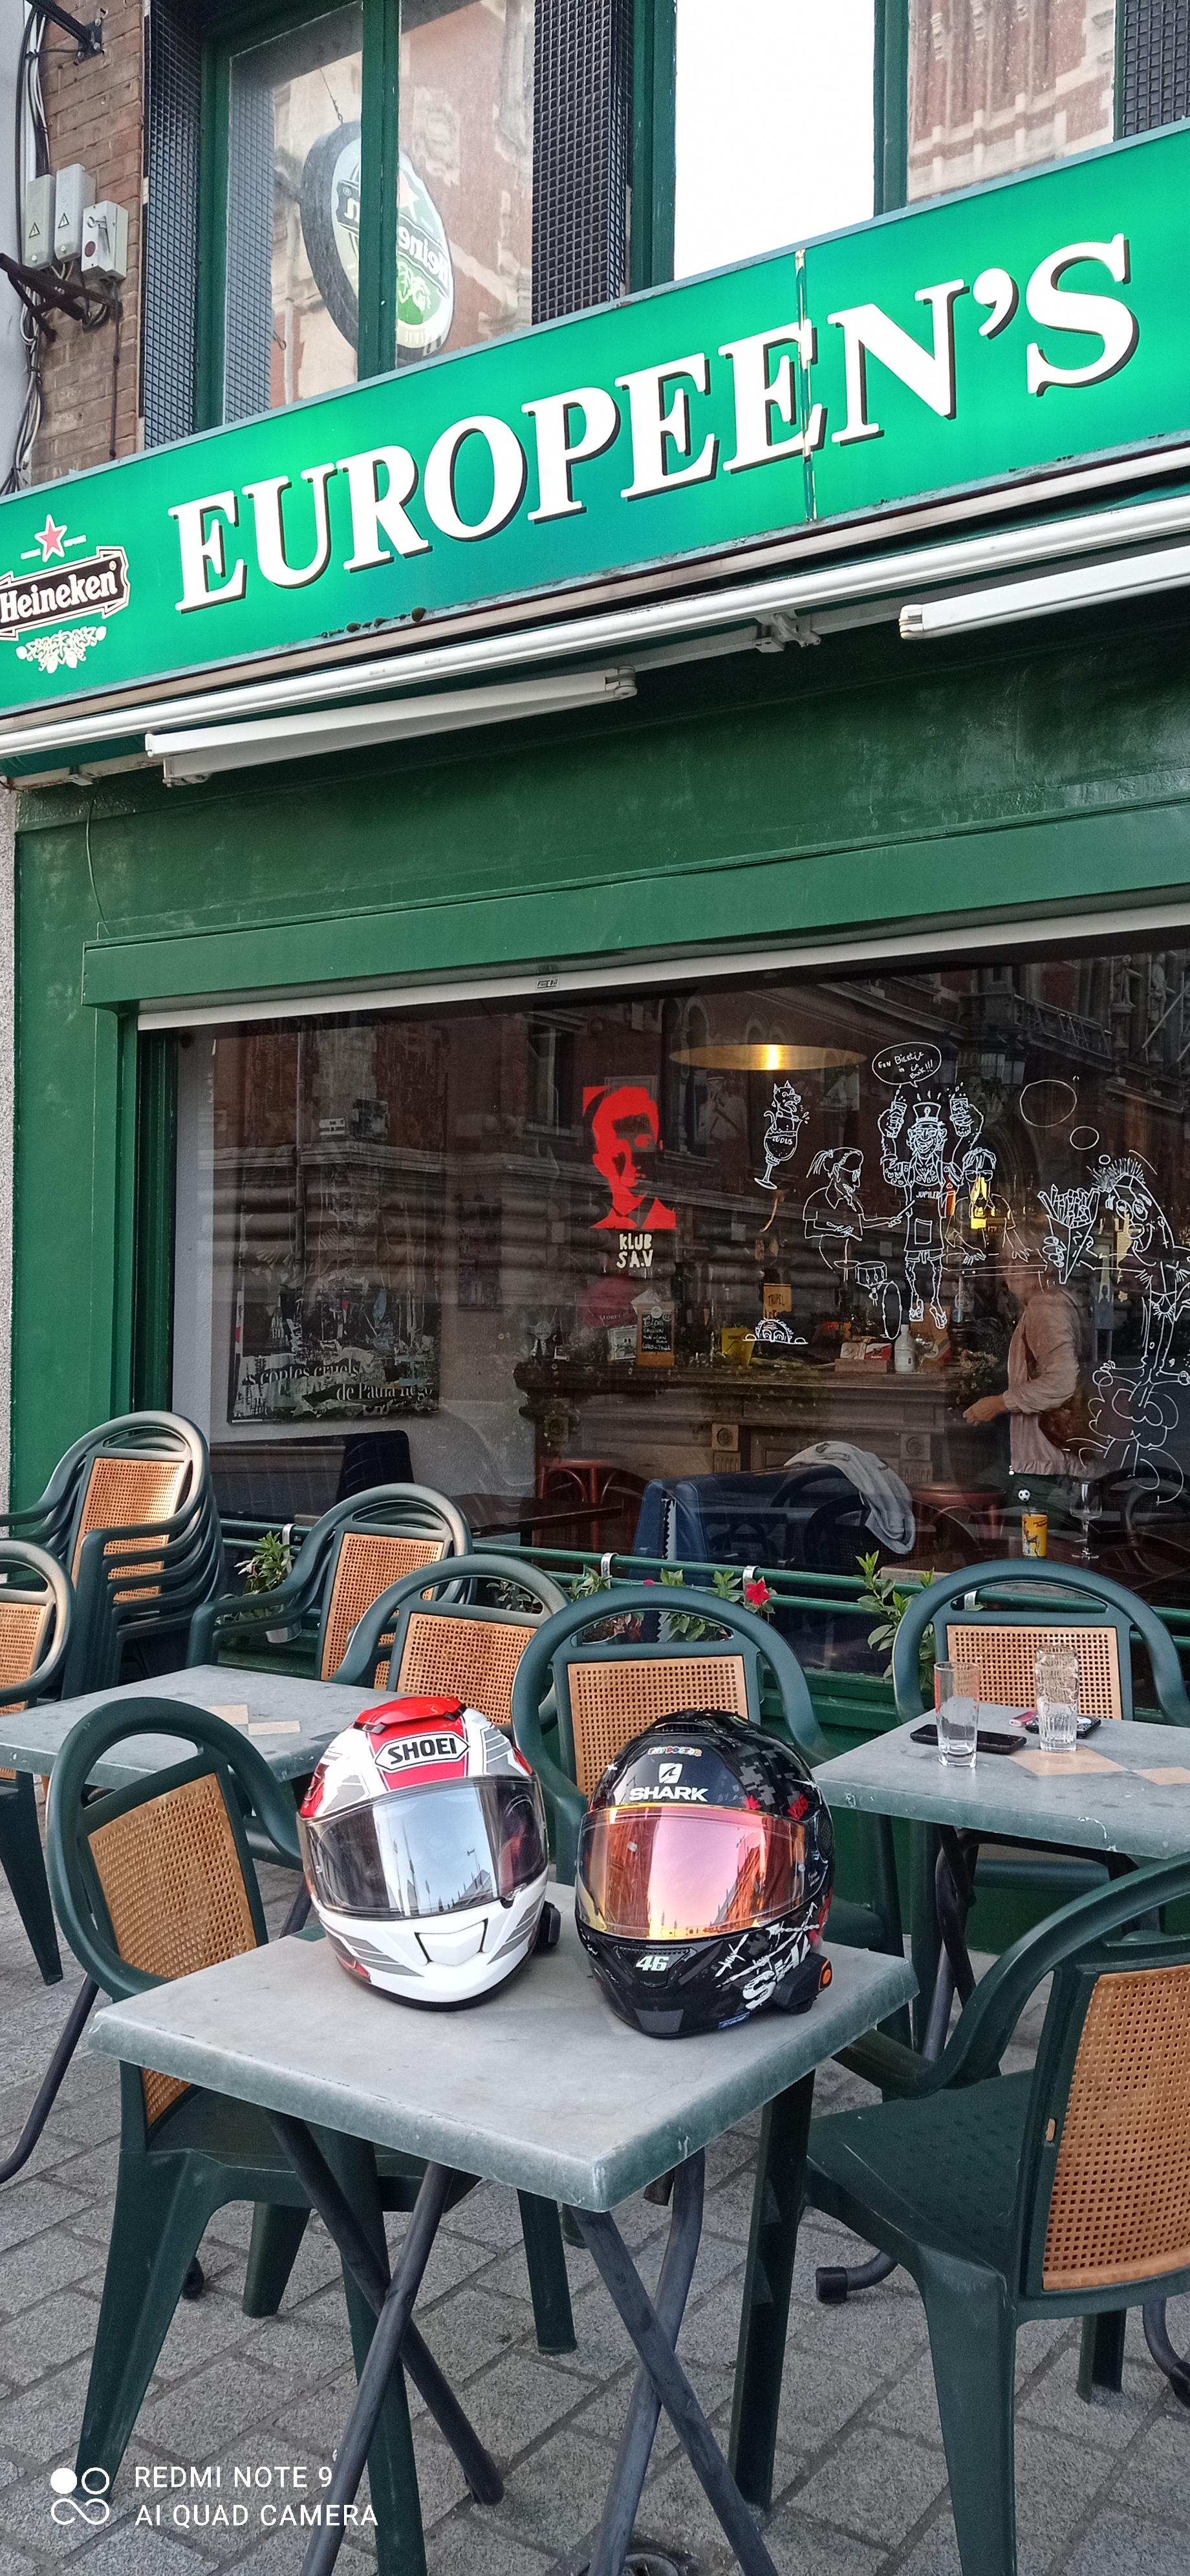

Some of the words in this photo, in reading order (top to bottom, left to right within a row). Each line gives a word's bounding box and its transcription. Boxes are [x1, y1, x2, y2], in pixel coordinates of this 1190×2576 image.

[168, 233, 1139, 614] EUROPEEN'S
[0, 571, 118, 623] Heineken
[620, 1232, 652, 1250] KLUB
[336, 1382, 354, 1401] de
[388, 1737, 457, 1765] SHOEI
[629, 1786, 709, 1803] SHARK
[635, 1955, 670, 1971] 46
